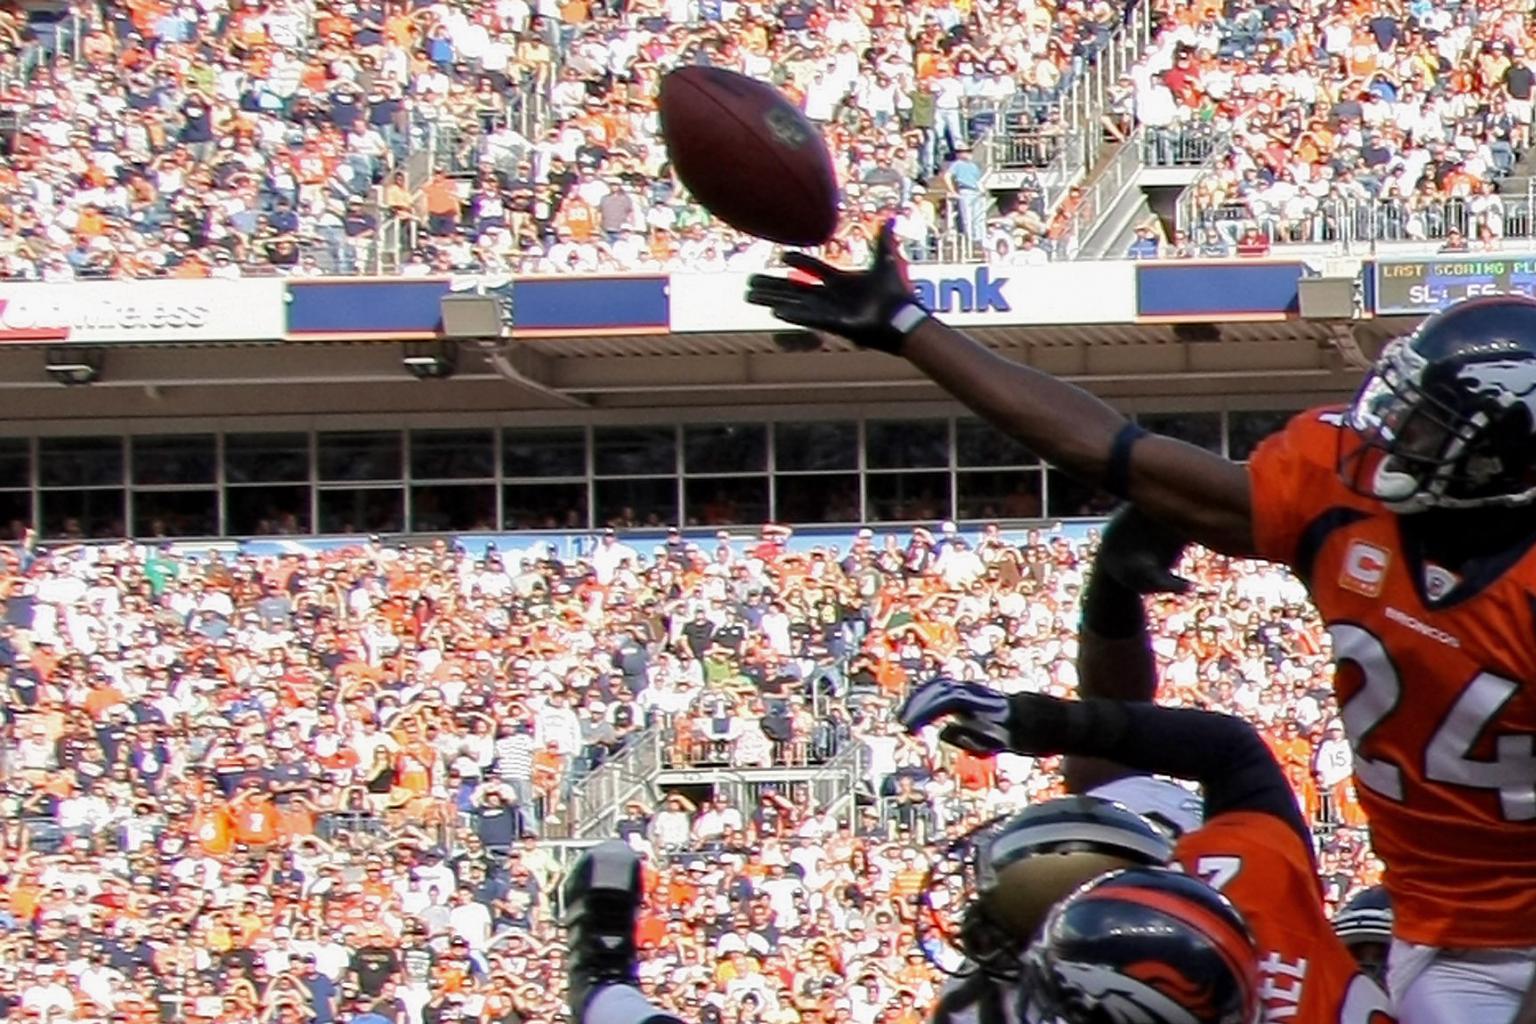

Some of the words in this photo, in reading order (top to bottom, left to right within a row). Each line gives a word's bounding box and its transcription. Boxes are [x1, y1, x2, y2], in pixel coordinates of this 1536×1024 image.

[1383, 265, 1423, 277] LAST
[1434, 262, 1505, 275] SCORING
[1346, 542, 1388, 584] C
